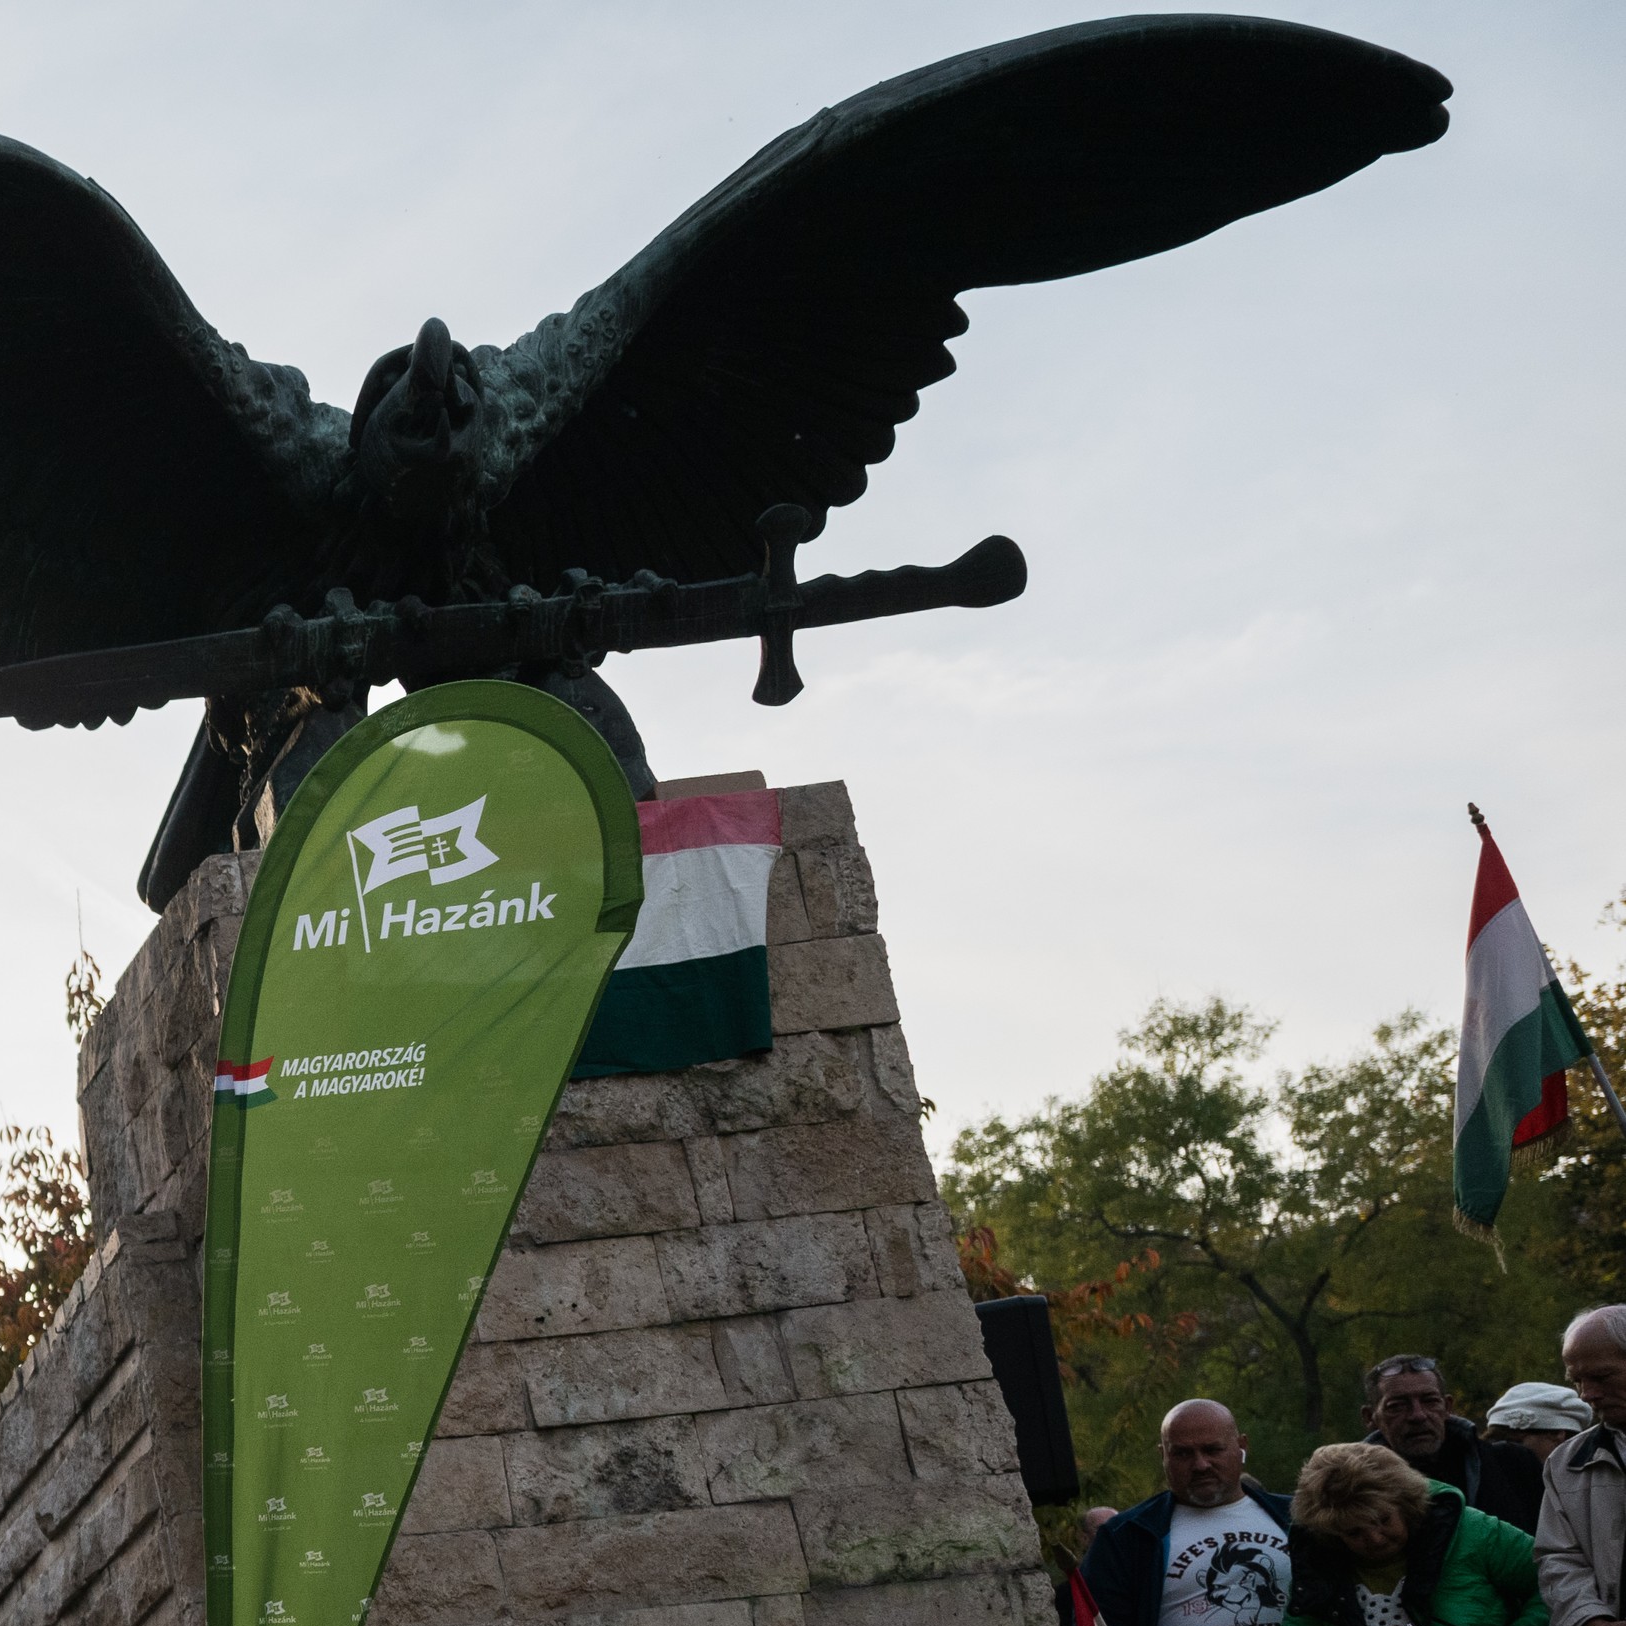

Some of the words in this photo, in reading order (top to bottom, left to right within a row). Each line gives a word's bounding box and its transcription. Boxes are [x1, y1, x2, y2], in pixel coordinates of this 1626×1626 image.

[292, 906, 351, 952] Mi
[378, 881, 558, 940] Hazánk
[280, 1041, 427, 1078] MAGYARORSZÁG
[293, 1079, 308, 1099] A
[309, 1065, 426, 1097] MAGYAROKÉ!
[257, 1411, 268, 1419] Mi
[272, 1409, 299, 1418] Hazánk
[369, 1404, 399, 1412] Hazánk
[258, 1514, 268, 1522] Mi
[271, 1512, 297, 1520] Hazánk
[368, 1508, 397, 1516] Hazánk
[1166, 1536, 1218, 1580] LIFE'S
[1222, 1531, 1292, 1557] BRUTA
